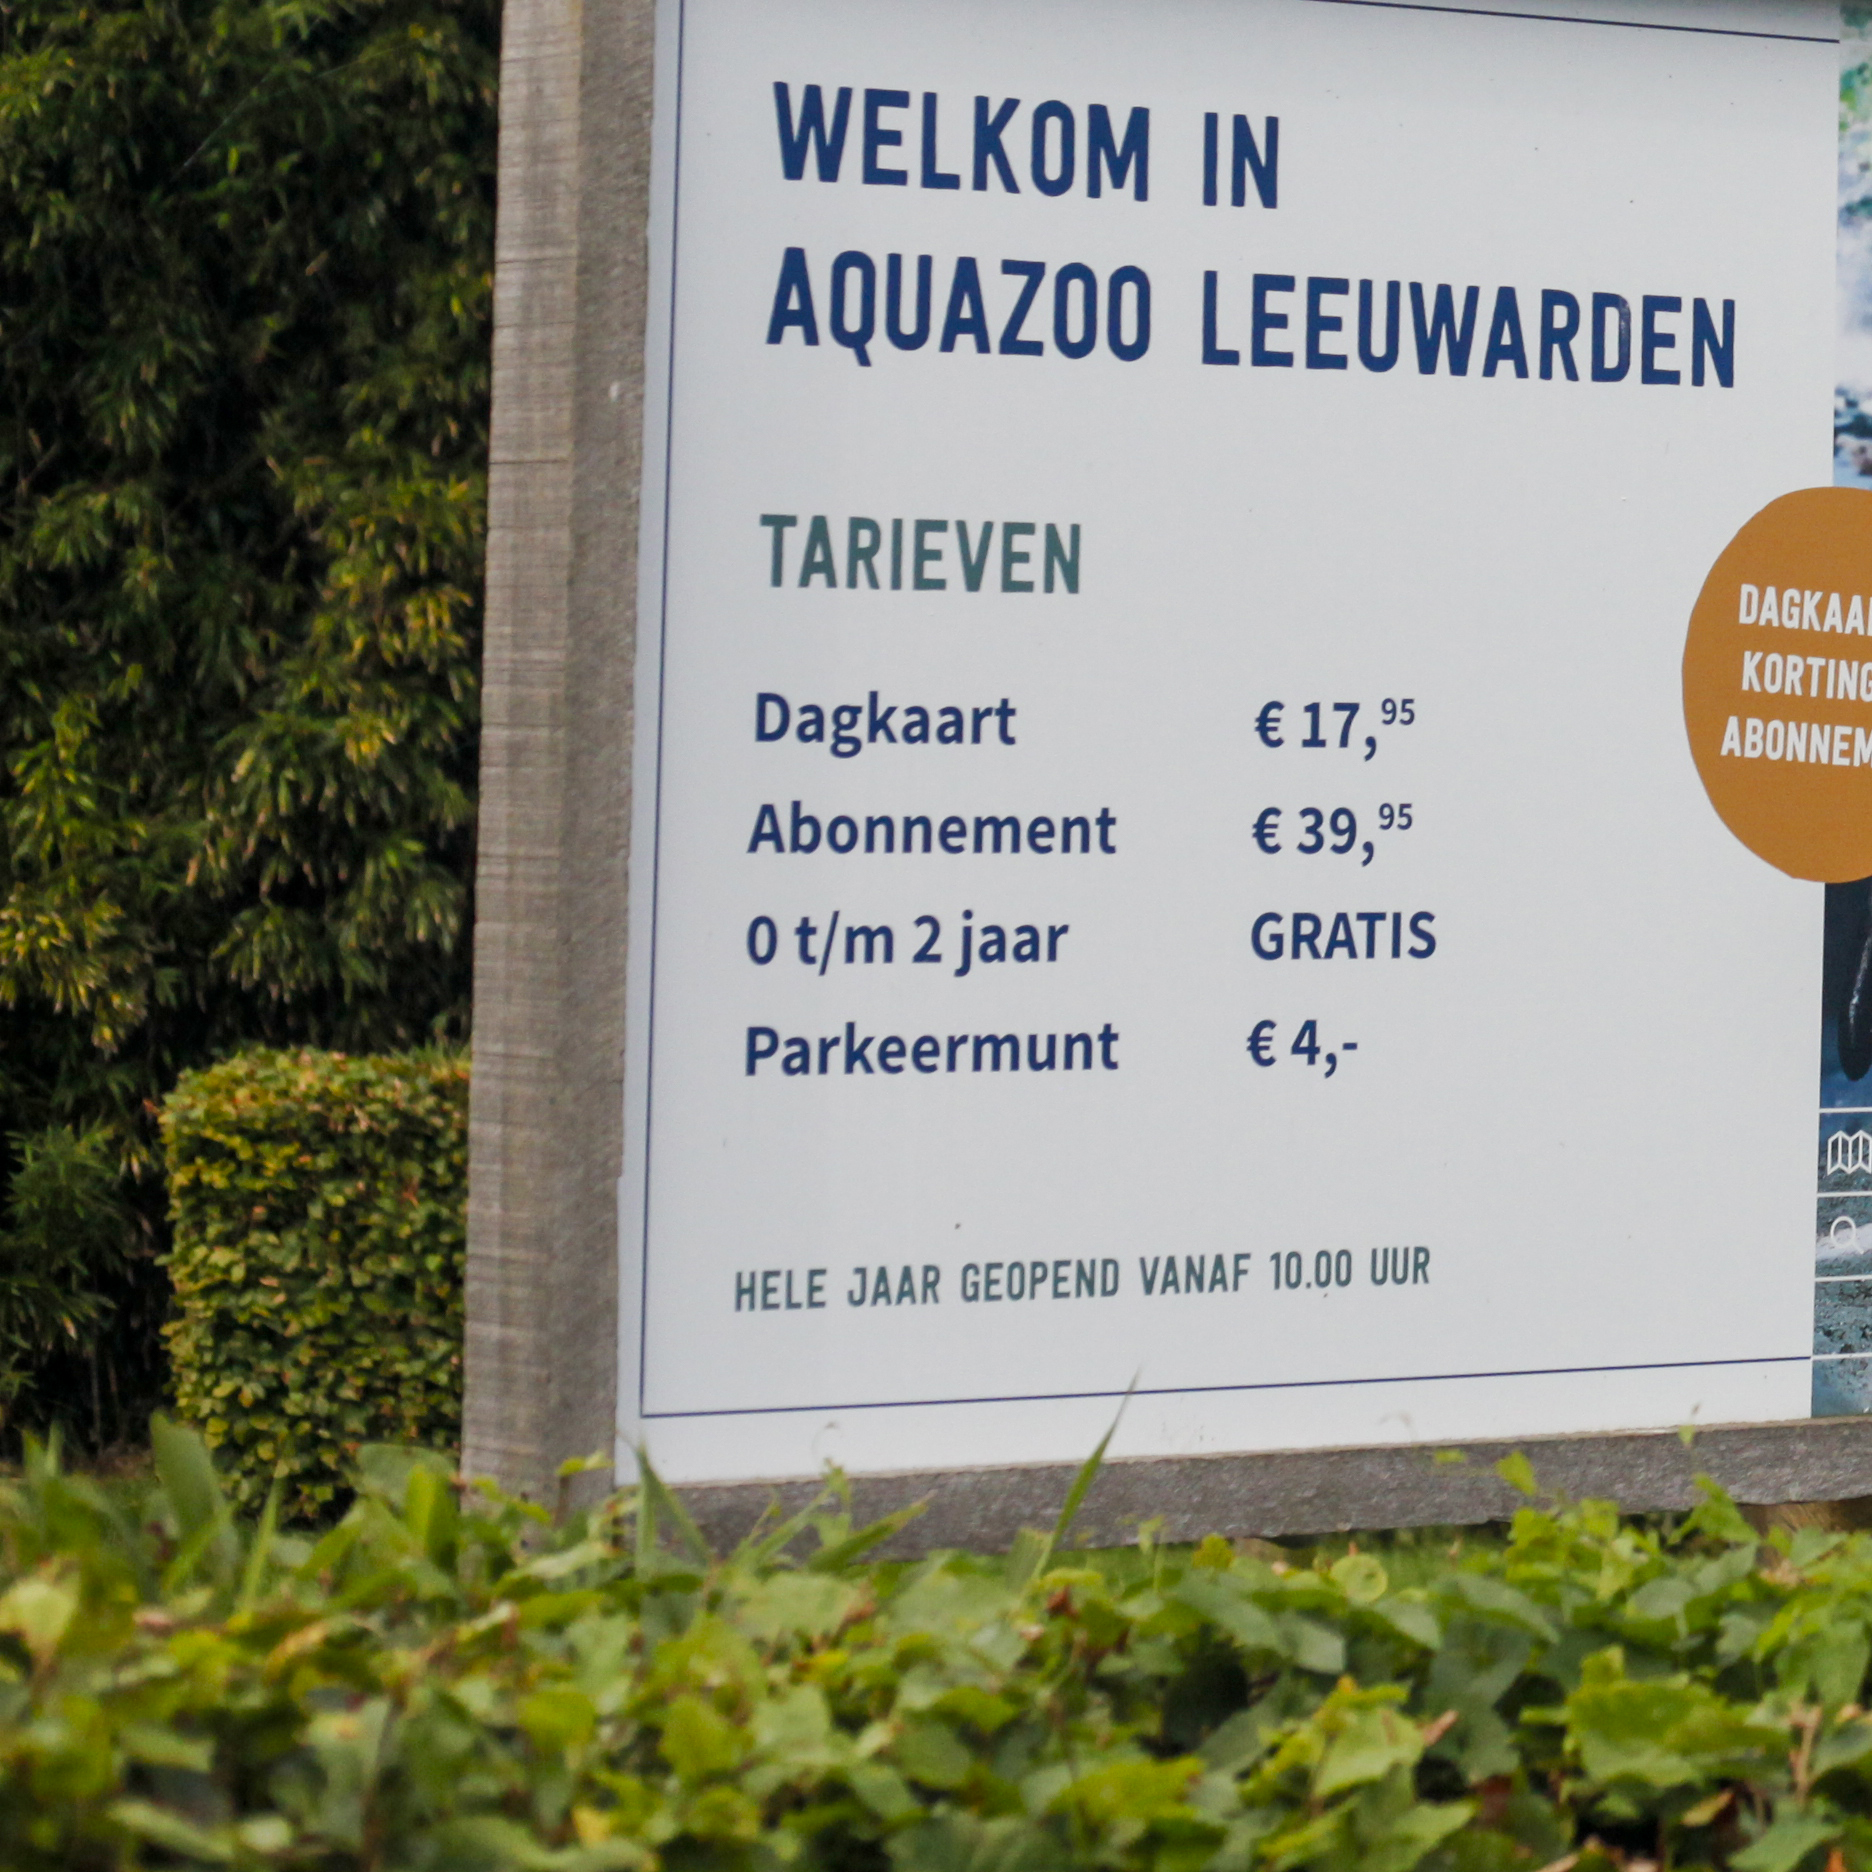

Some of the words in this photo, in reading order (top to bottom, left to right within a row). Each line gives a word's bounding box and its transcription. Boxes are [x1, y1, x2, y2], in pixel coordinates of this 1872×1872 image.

[773, 81, 1150, 202] WELKOM
[1202, 111, 1279, 210] IN
[766, 246, 1151, 368] AQUAZOO
[1201, 270, 1736, 389] LEEUWARDEN
[759, 513, 1081, 595] TARIEVEN
[755, 690, 1017, 759] Dagkaart
[1254, 700, 1285, 749] €
[747, 800, 1117, 855] Abonnement
[1252, 806, 1282, 855] €
[746, 915, 778, 966] 0
[794, 910, 894, 976] t/m
[912, 914, 942, 964] 2
[954, 909, 1070, 978] jaar
[1251, 910, 1437, 961] GRATIS
[745, 1021, 1119, 1077] Parkeermunt
[1246, 1019, 1277, 1068] €
[1290, 1019, 1358, 1079] 4,-
[735, 1268, 827, 1312] HELE
[847, 1264, 941, 1308] JAAR
[961, 1258, 1120, 1303] GEOPEND
[1139, 1252, 1252, 1296] VANAF
[1269, 1248, 1353, 1290] 10.00
[1370, 1246, 1431, 1286] UUR
